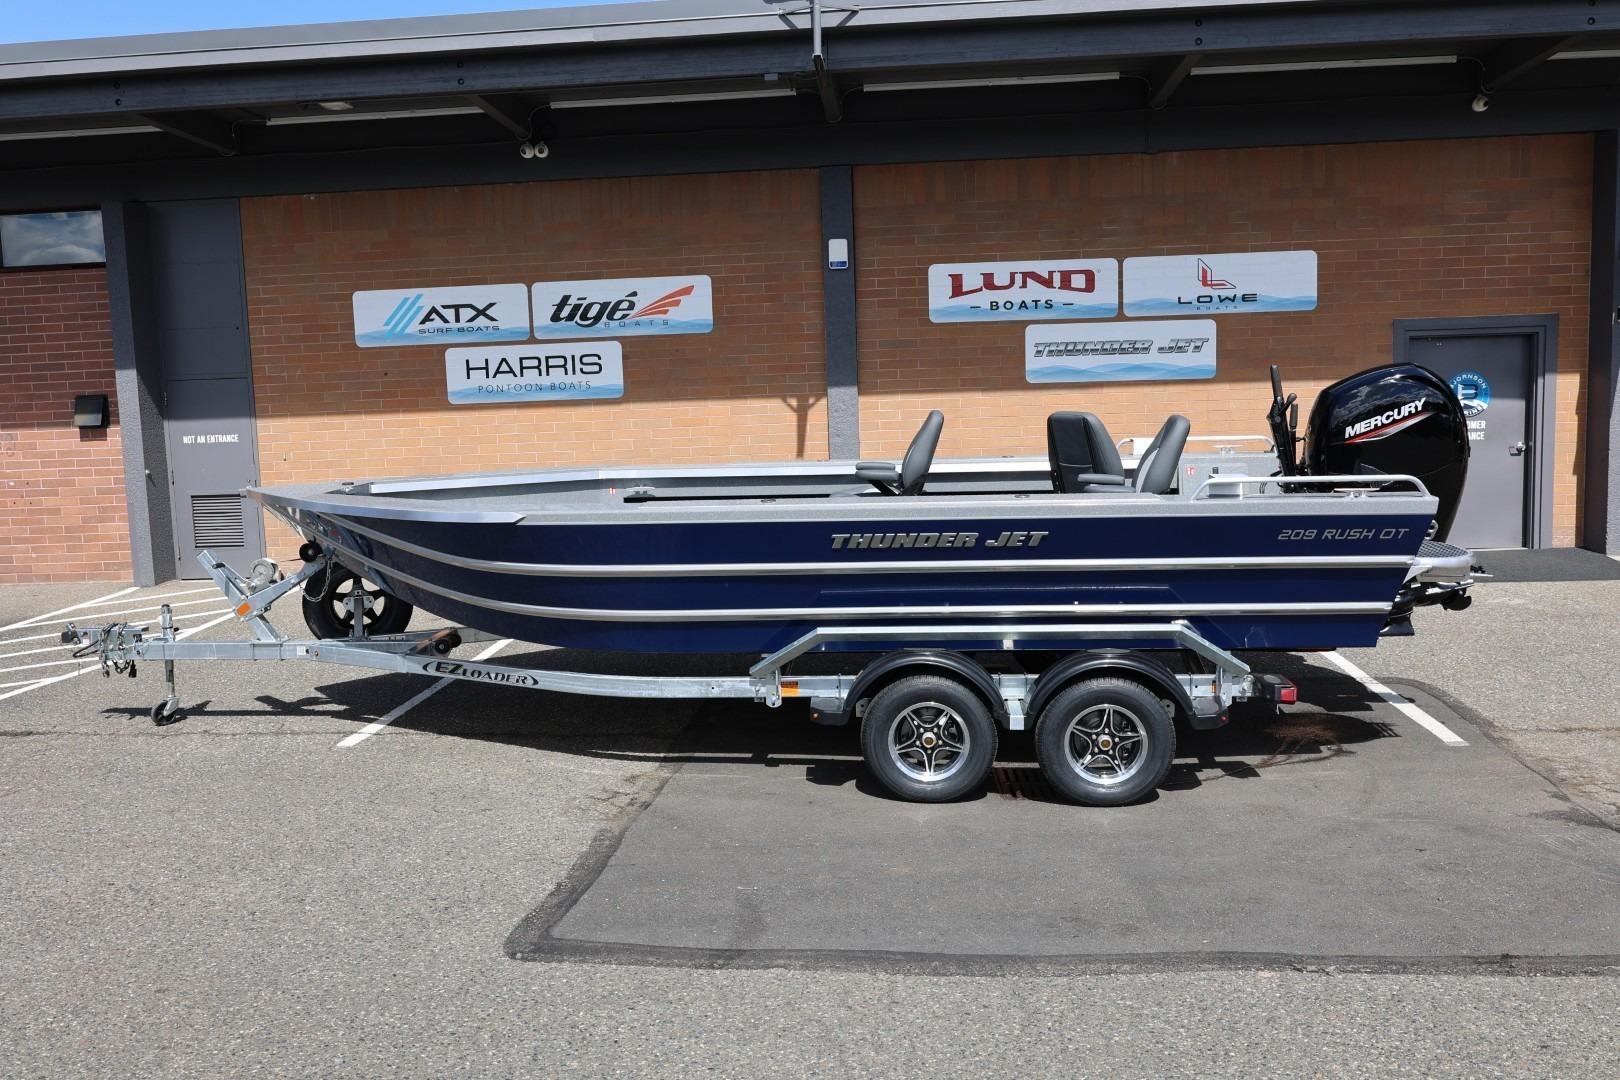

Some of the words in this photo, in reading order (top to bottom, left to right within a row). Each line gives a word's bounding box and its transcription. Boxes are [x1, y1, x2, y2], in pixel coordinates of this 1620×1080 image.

[948, 269, 1096, 299] LUND
[989, 299, 1054, 311] BOATS
[1177, 293, 1258, 305] LOWE
[419, 302, 499, 325] ATX
[550, 291, 637, 328] tigé
[457, 325, 500, 333] BOATS
[604, 320, 669, 328] BOATS
[1033, 339, 1153, 357] THUNDER
[1157, 337, 1210, 354] JET
[465, 353, 602, 380] HARRIS
[478, 383, 543, 394] PONTOON
[550, 380, 591, 391] BOATS
[1344, 397, 1426, 438] MERCURY
[183, 435, 195, 444] NOT
[197, 435, 205, 444] AN
[207, 434, 239, 443] ENTRANCE
[831, 533, 979, 549] THUNDER
[985, 531, 1049, 547] JET
[1277, 529, 1317, 540] 209
[1321, 529, 1376, 540] RUSH
[1379, 528, 1410, 540] OT
